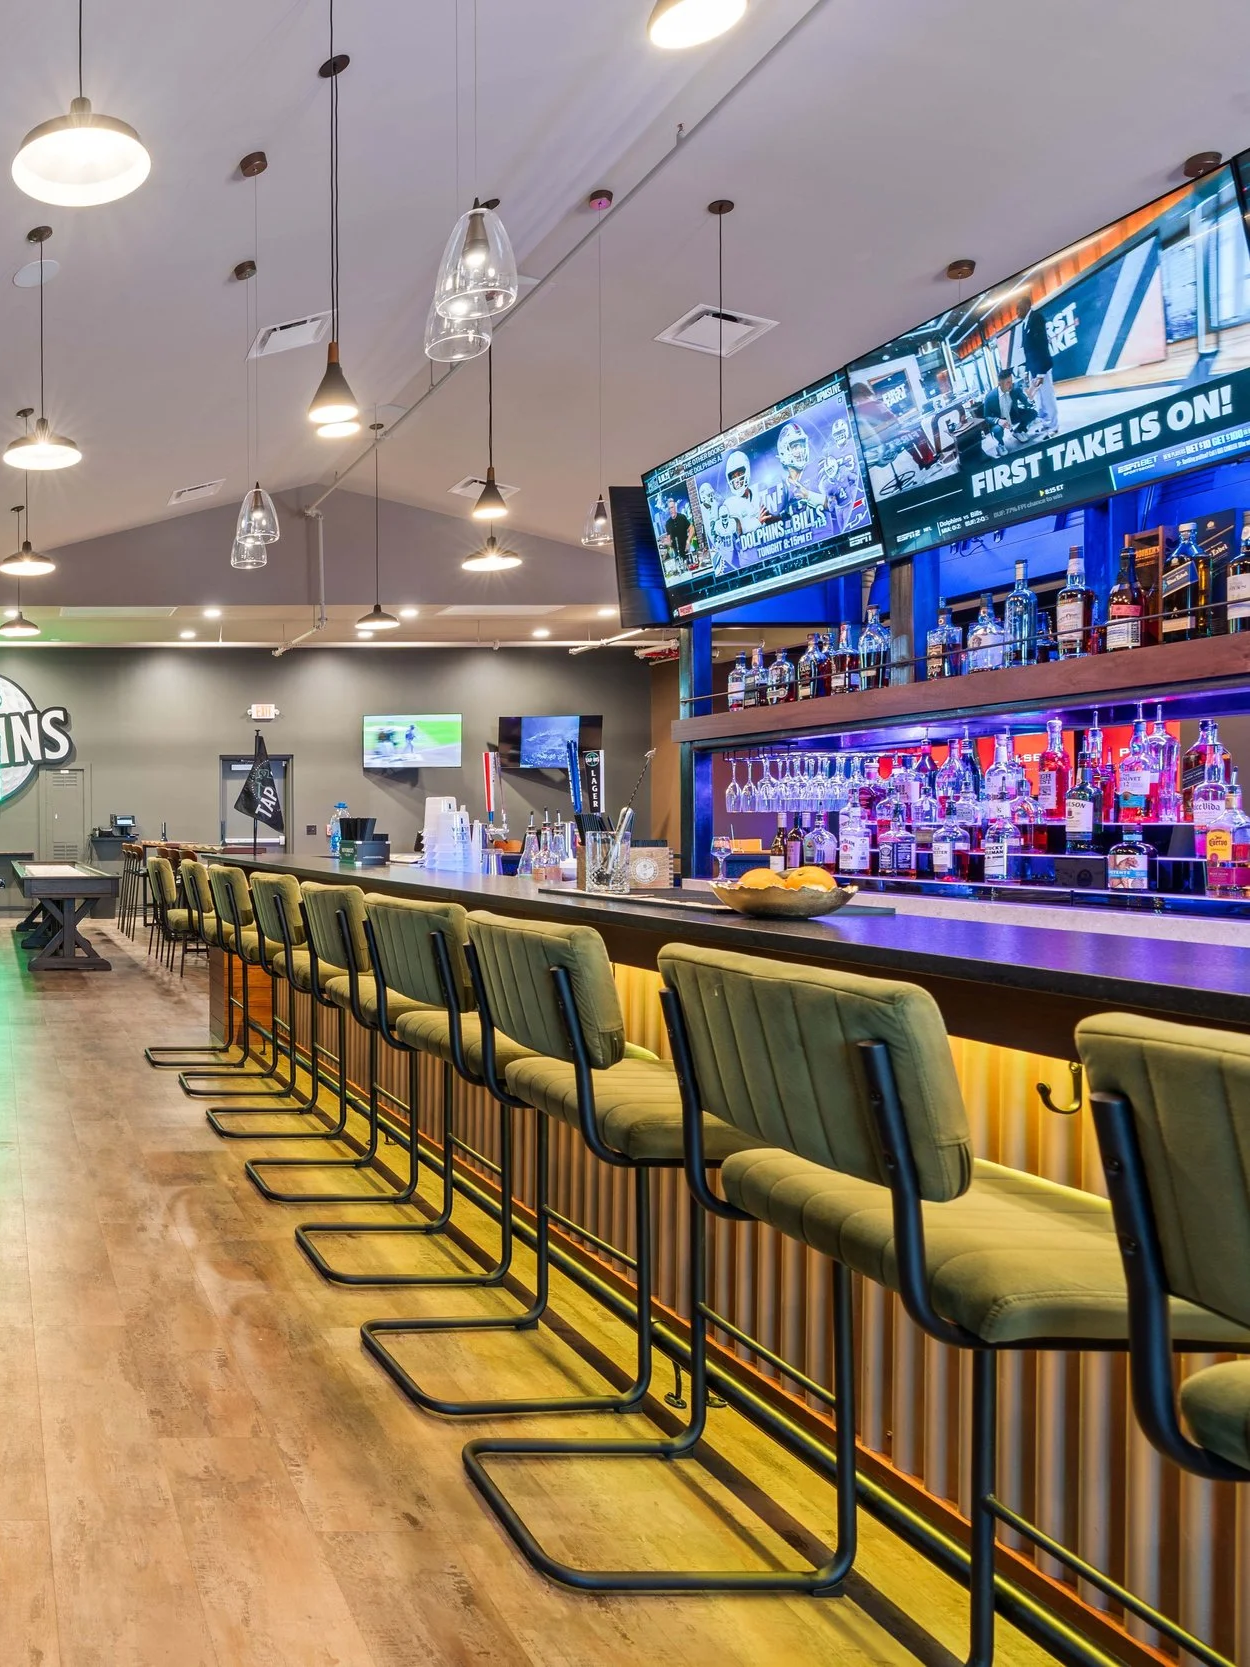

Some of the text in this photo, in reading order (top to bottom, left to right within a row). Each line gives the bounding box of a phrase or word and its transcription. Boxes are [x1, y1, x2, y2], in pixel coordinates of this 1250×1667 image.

[1045, 302, 1077, 338] RST
[1048, 326, 1078, 357] AKE
[971, 451, 1043, 498] FIRST
[1046, 423, 1124, 472] TAKE
[1128, 410, 1160, 446] IS
[1166, 385, 1233, 431] ON!
[760, 483, 783, 513] TNF
[740, 520, 785, 551] DOLPHINS
[792, 505, 825, 530] BILLS
[939, 516, 963, 528] Dolphins
[970, 510, 983, 519] Bills
[849, 532, 872, 547] ESPN
[896, 530, 921, 543] ESPN2
[757, 542, 782, 558] TONIGHT
[1211, 543, 1228, 558] Label
[591, 770, 599, 808] LAGER
[255, 786, 277, 818] TAP
[1202, 802, 1220, 810] Vida
[1208, 838, 1227, 847] Cuervo
